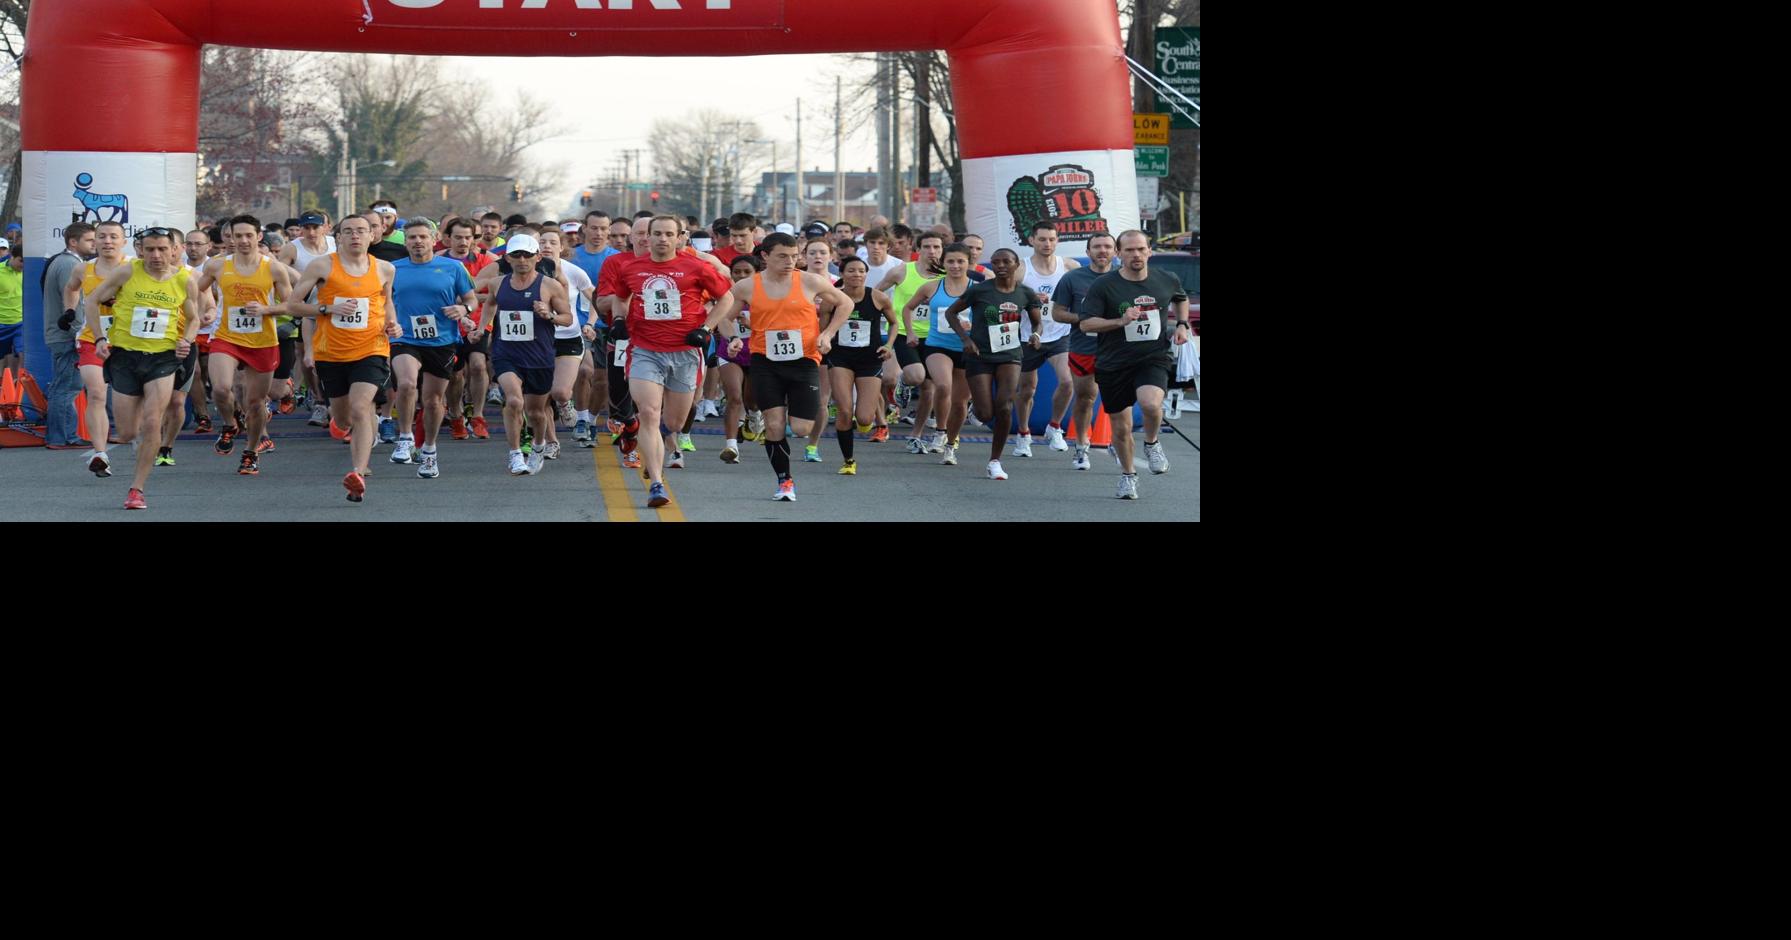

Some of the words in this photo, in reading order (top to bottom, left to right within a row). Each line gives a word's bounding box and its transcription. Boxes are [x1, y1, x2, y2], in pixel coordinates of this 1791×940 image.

[1134, 118, 1161, 129] LOW
[1053, 188, 1098, 219] 10
[1055, 219, 1105, 234] MILER
[654, 302, 670, 314] 38
[916, 307, 929, 317] 51
[142, 321, 156, 332] 11
[236, 317, 256, 328] 144
[414, 326, 436, 338] 169
[506, 323, 527, 335] 140
[1136, 324, 1151, 335] 47
[850, 331, 857, 341] 5
[1000, 334, 1011, 346] 18
[773, 342, 796, 355] 133
